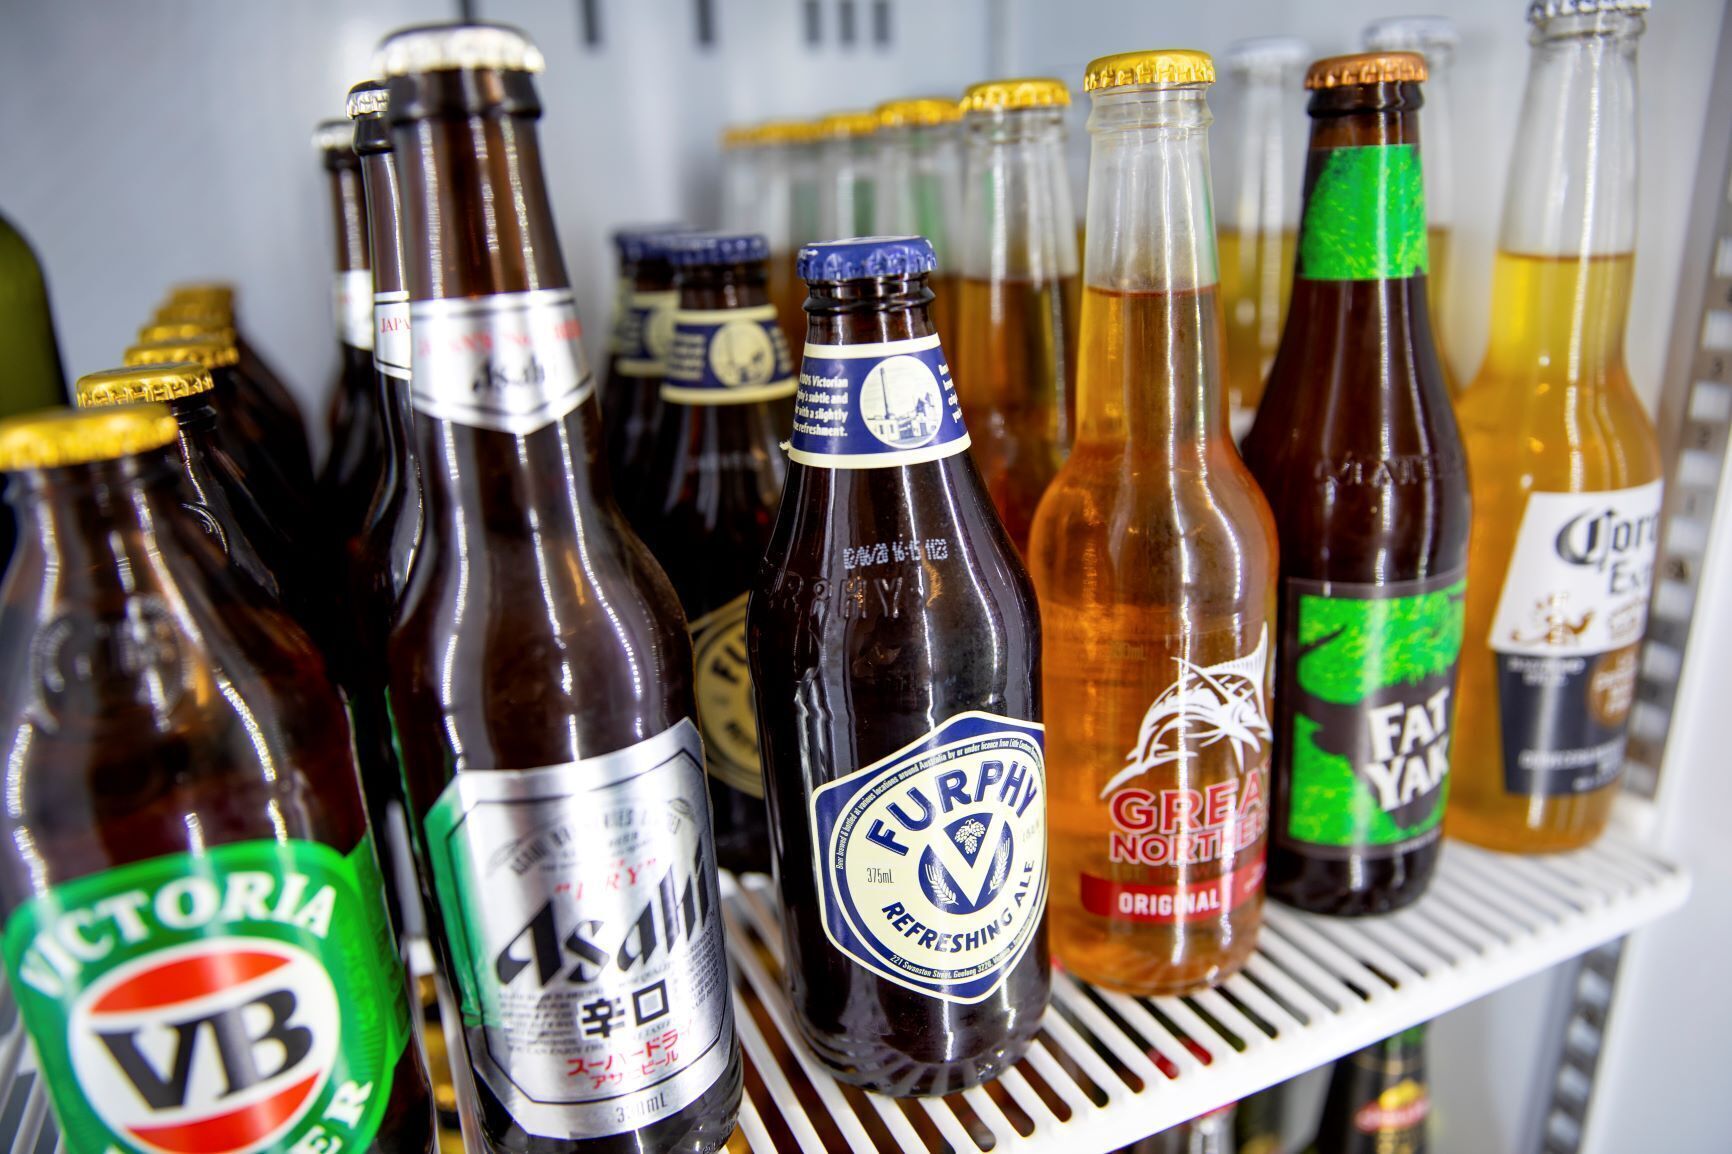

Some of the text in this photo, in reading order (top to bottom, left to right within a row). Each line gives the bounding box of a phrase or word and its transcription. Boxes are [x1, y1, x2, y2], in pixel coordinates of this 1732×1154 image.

[812, 375, 848, 388] Victorian
[815, 407, 848, 423] slightly
[831, 391, 848, 404] and
[1368, 687, 1450, 763] FAT
[859, 792, 877, 813] various
[873, 775, 899, 796] locations
[898, 765, 920, 781] around
[865, 759, 1038, 857] FURPHY
[1364, 735, 1450, 813] YAK
[866, 866, 895, 885] 375mL
[882, 900, 1013, 954] REFRESHING
[1014, 859, 1035, 908] ALE
[18, 870, 338, 999] VICTORIA
[496, 834, 710, 988] Asahi
[902, 960, 932, 977] Swanston
[581, 978, 670, 1038] 辛口
[91, 987, 315, 1113] VB
